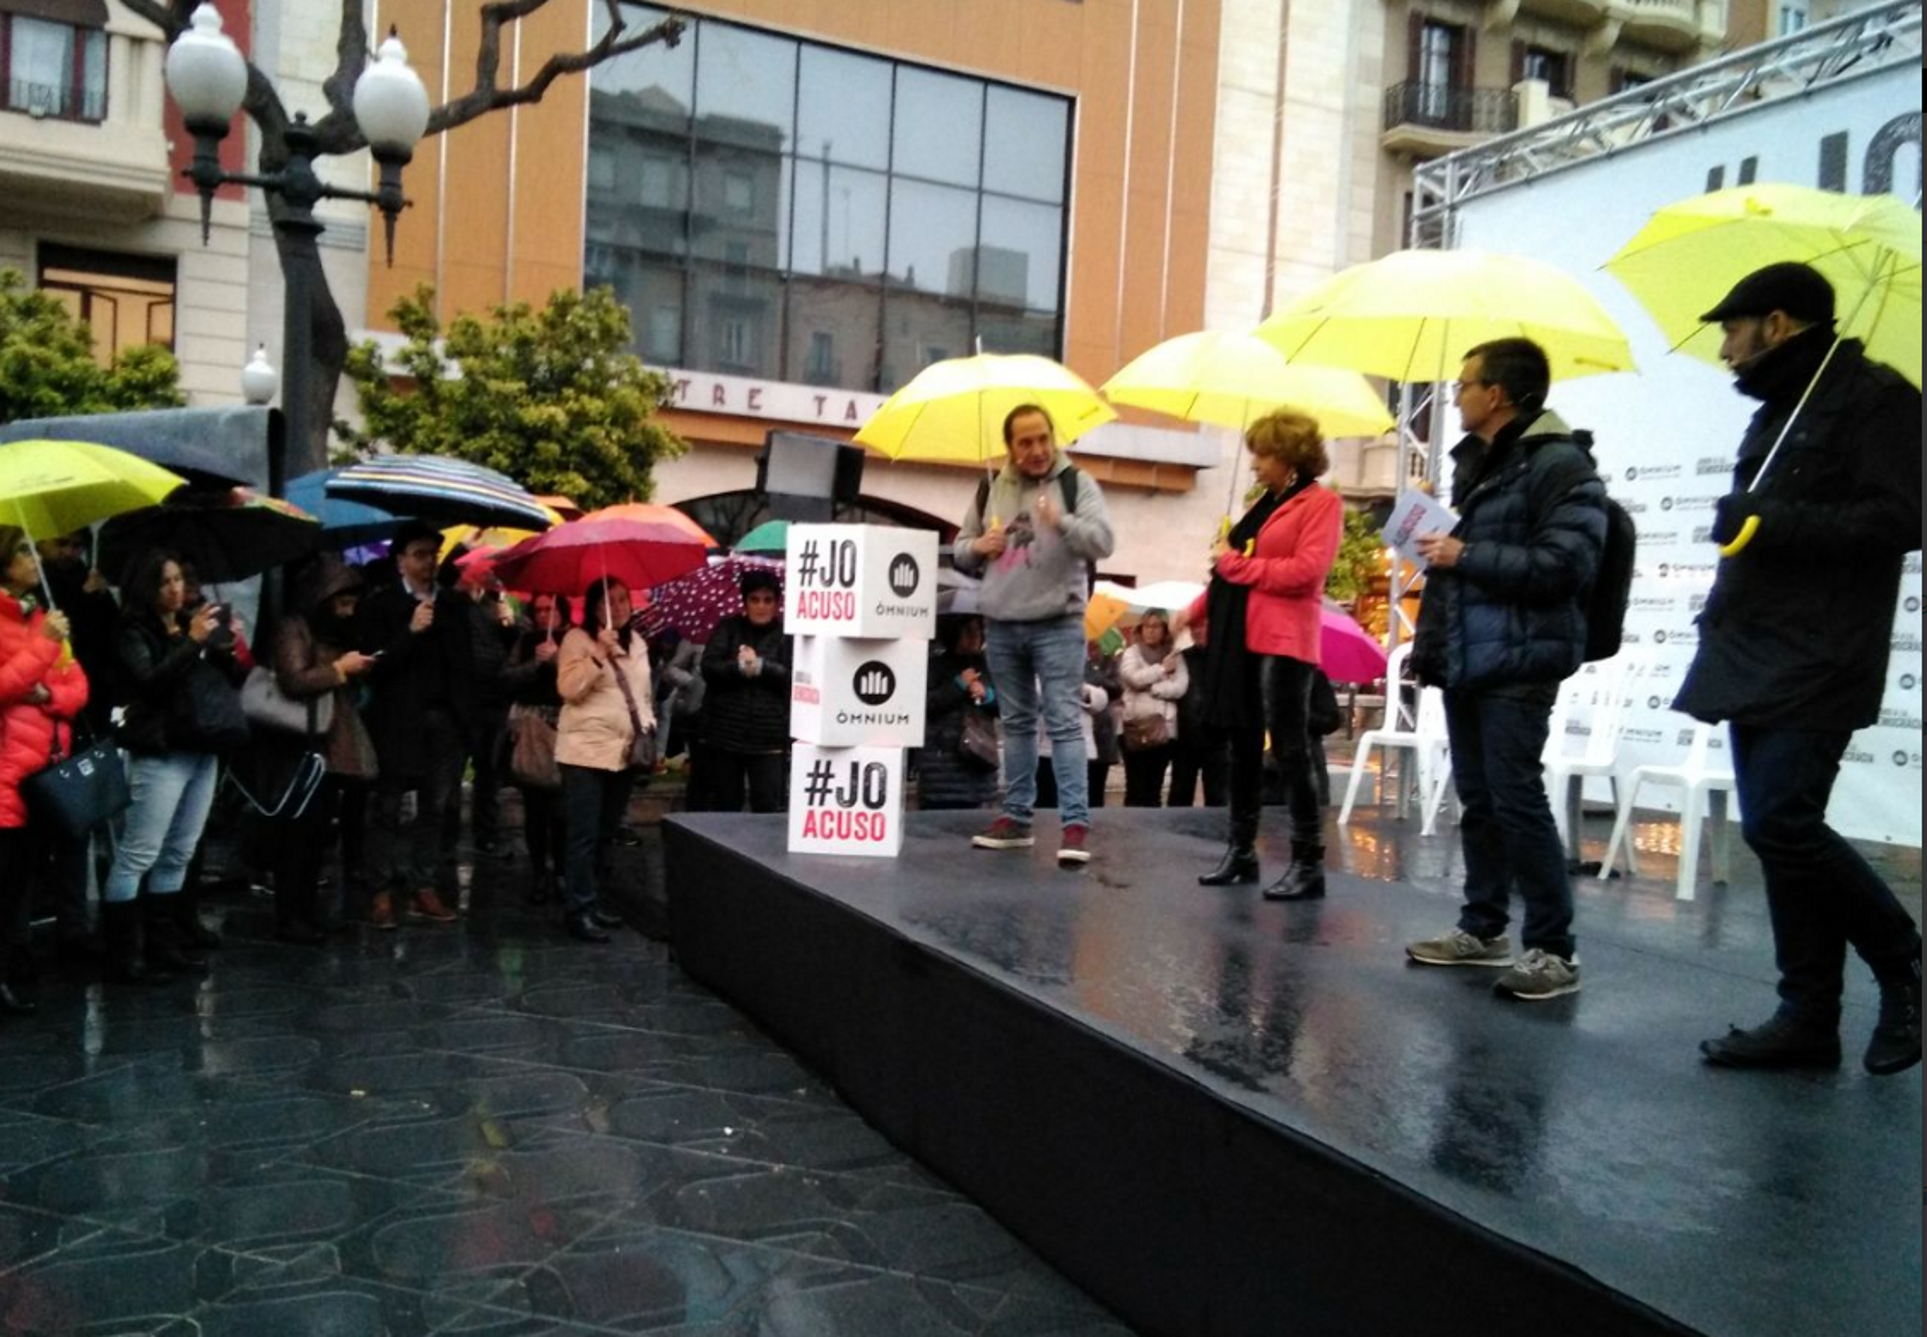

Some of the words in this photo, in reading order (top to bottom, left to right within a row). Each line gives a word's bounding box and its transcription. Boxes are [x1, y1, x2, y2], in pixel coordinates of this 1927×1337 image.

[813, 395, 883, 421] TA
[798, 539, 857, 588] #JO
[796, 590, 856, 621] ACUSO
[836, 709, 910, 725] ÒMNIUM
[804, 759, 887, 810] #JO
[802, 810, 887, 842] ACUSO
